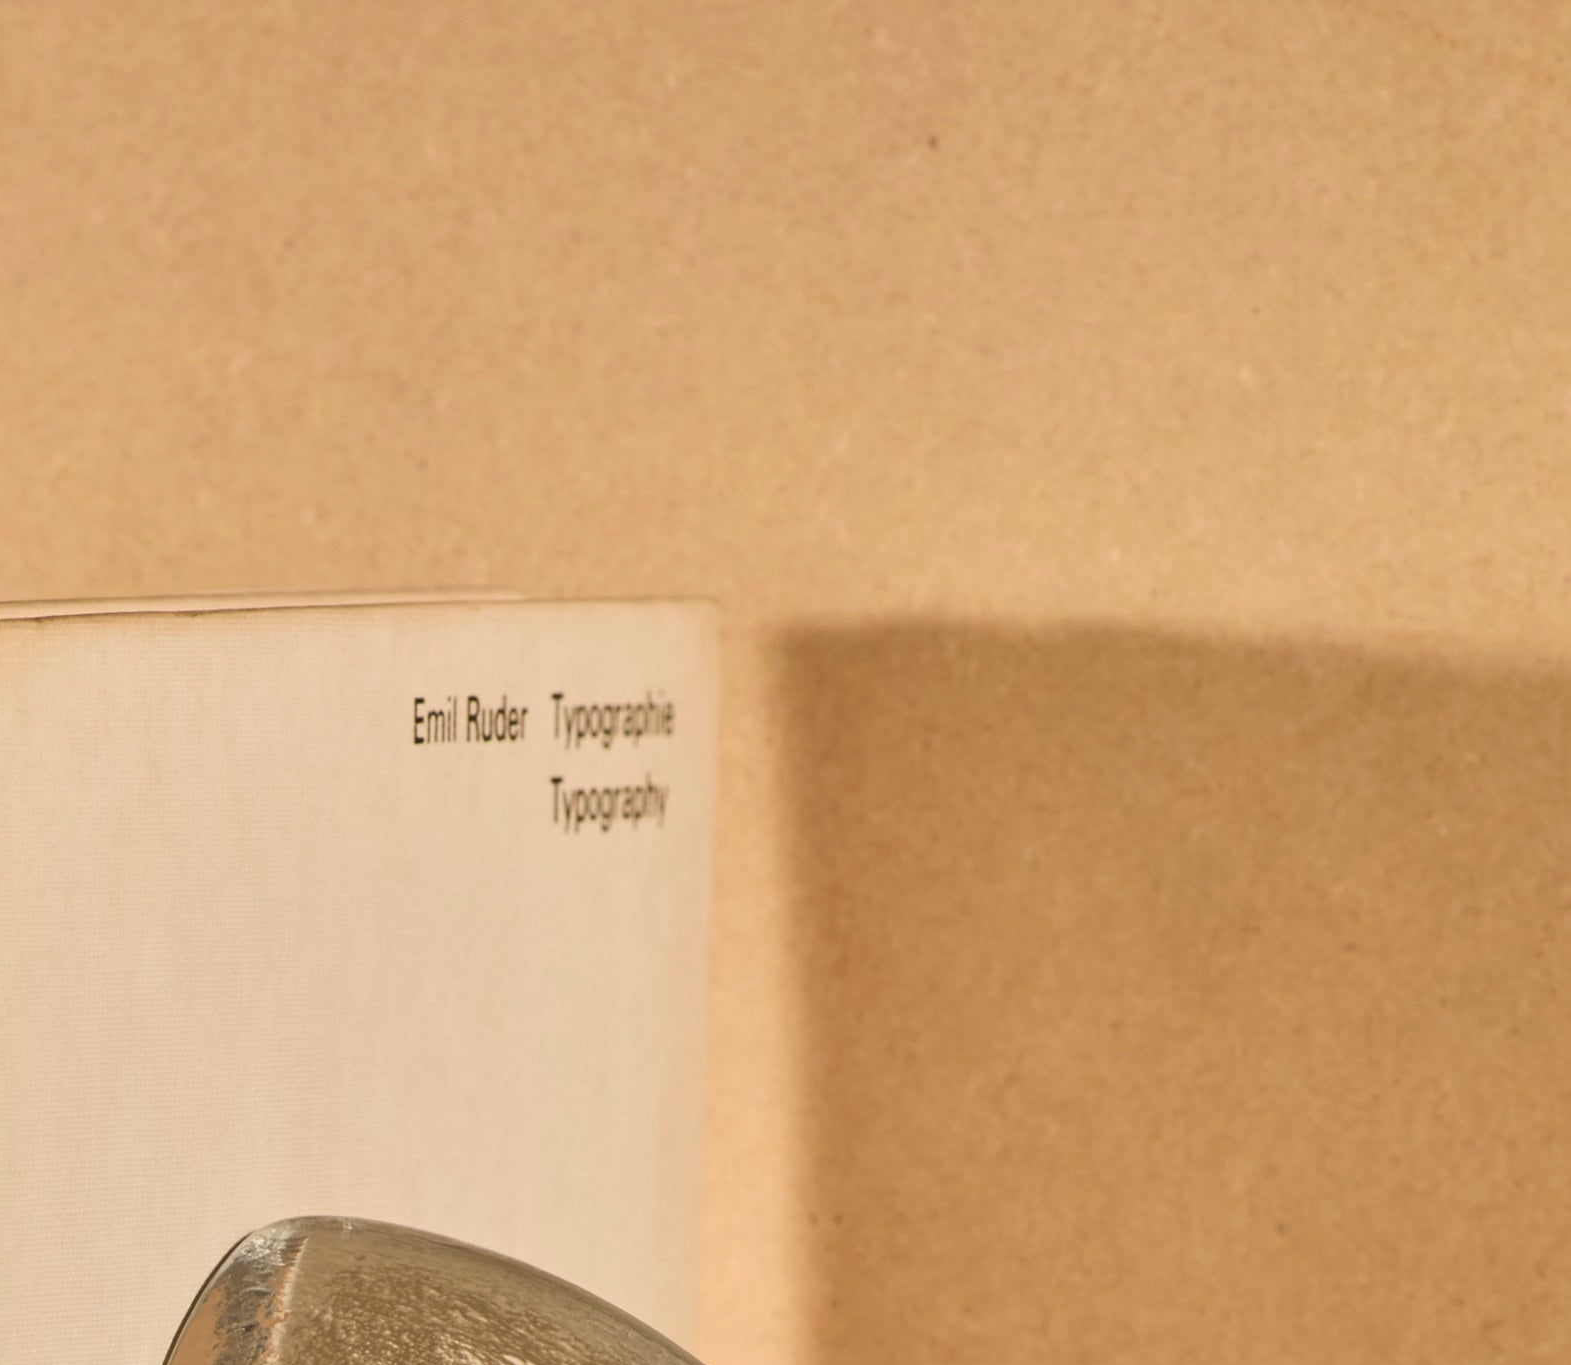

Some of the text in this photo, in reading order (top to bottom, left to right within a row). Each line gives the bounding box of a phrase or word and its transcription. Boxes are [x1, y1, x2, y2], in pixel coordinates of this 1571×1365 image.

[413, 691, 675, 749] Emil Ruder Typographie
[550, 775, 669, 833] Typography
